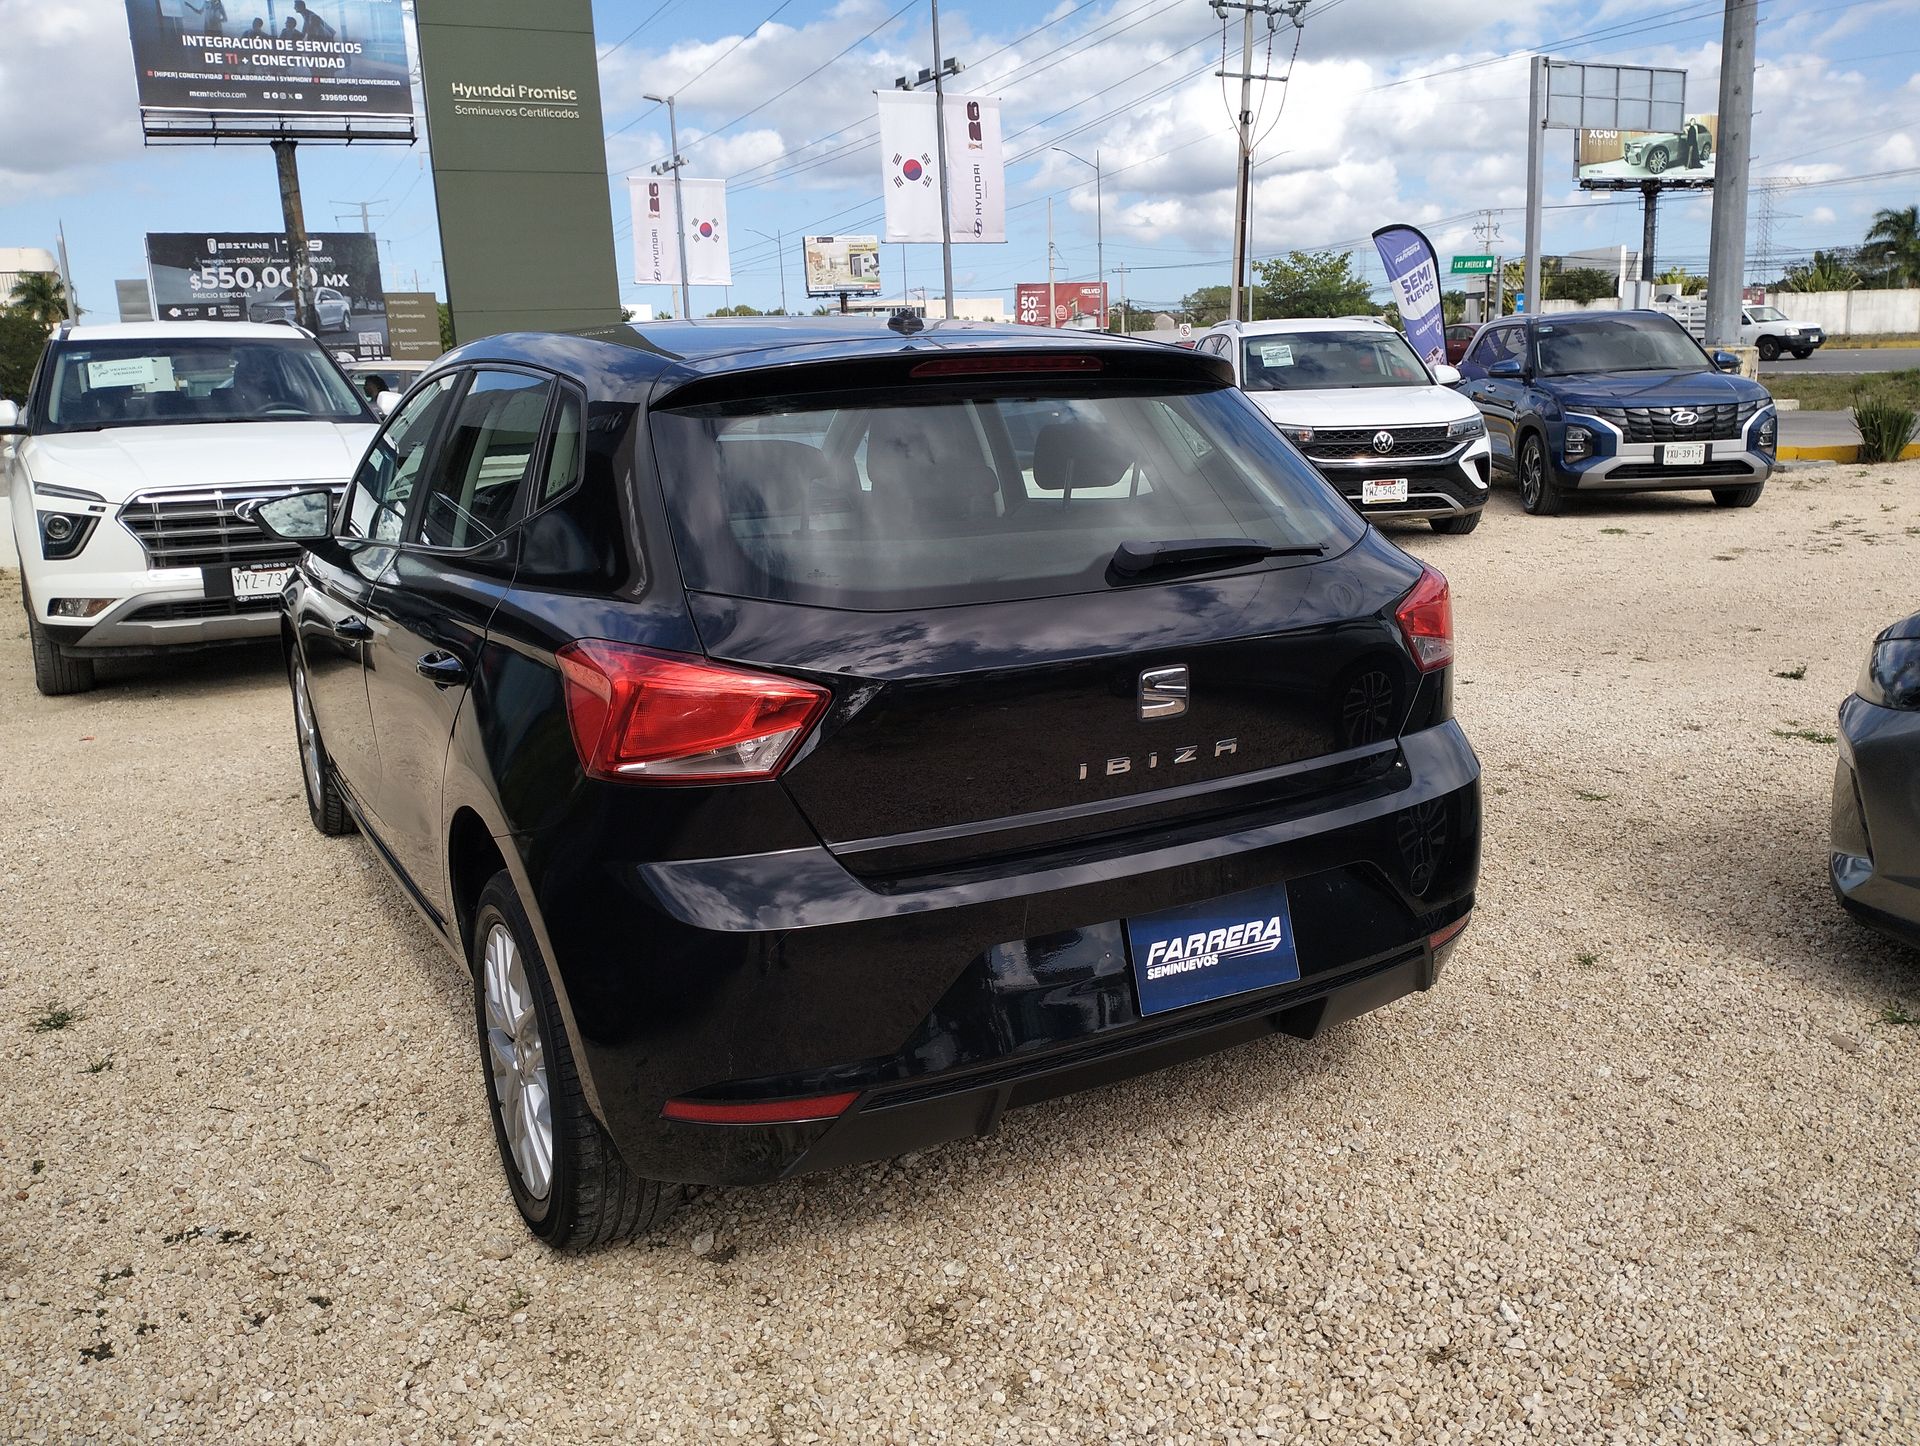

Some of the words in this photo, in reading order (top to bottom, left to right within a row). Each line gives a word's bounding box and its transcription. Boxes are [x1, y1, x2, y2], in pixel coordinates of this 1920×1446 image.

[182, 34, 273, 50] INTEGRACIÓN
[276, 39, 293, 51] DE
[295, 41, 362, 54] SERVICIOS
[204, 52, 223, 64] DE
[225, 53, 238, 64] TI
[252, 54, 345, 68] CONECTIVIDAD
[178, 72, 223, 80] CONECTIVIDAD
[189, 90, 247, 98] mcmtechco.com
[451, 82, 516, 98] Hyundai
[518, 85, 577, 100] Promise
[455, 105, 518, 117] Seminuevos
[519, 107, 580, 119] Certificados
[973, 164, 982, 215] HYUNDAI
[651, 229, 659, 267] HYUNDAI
[324, 274, 350, 287] MX
[1401, 264, 1431, 294] SEMI
[1078, 737, 1238, 781] IBIZA
[1146, 916, 1282, 966] FARRERA
[1147, 954, 1219, 980] SEMINUEVOS
